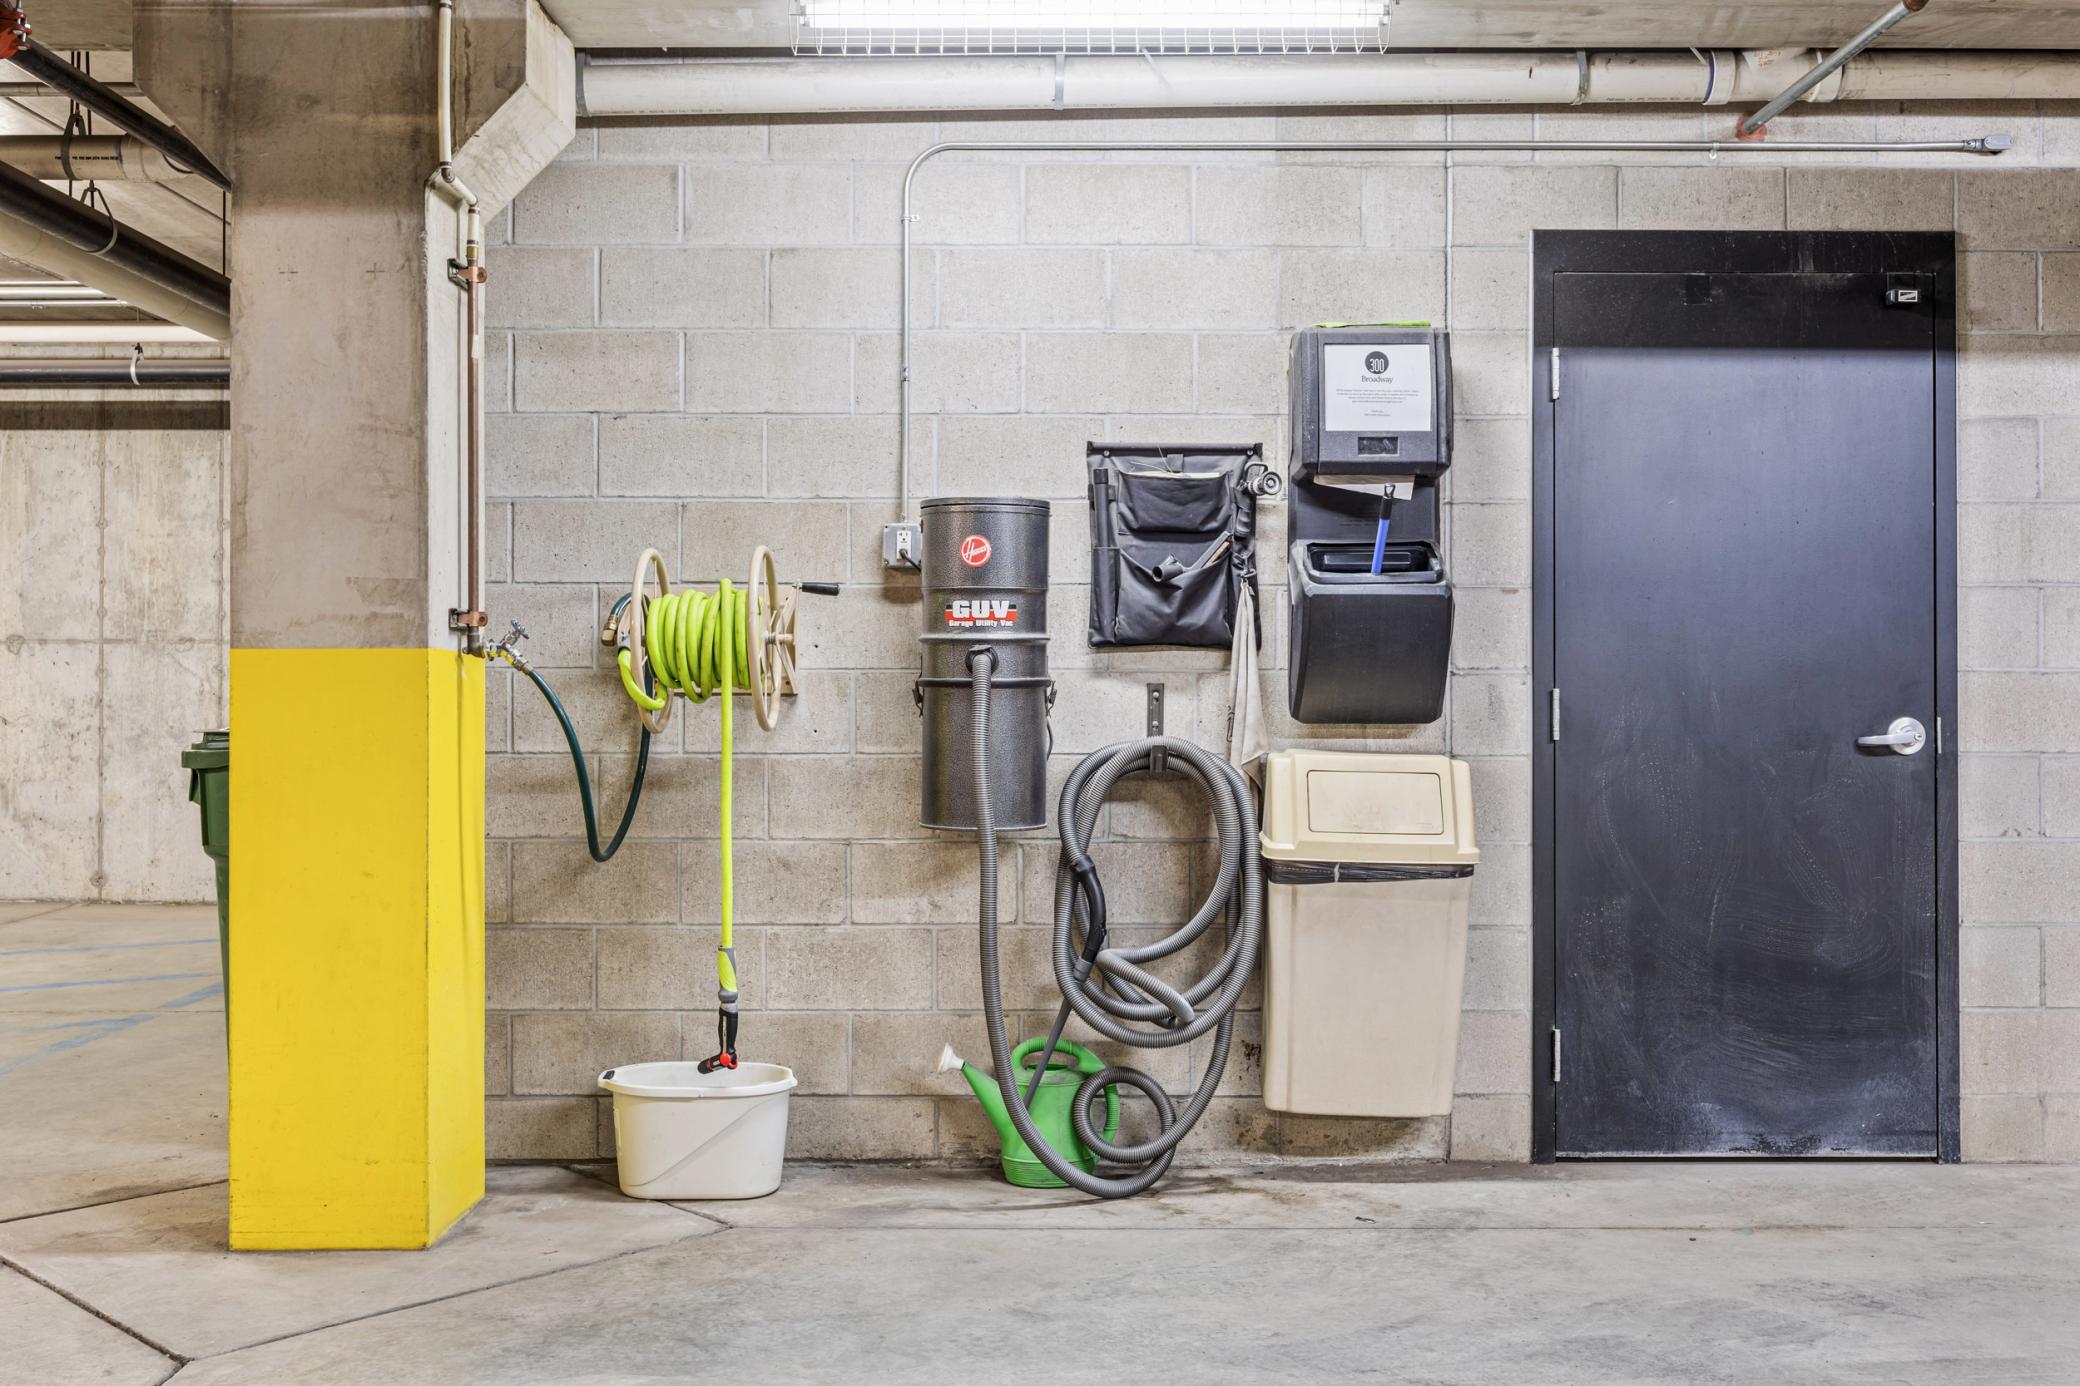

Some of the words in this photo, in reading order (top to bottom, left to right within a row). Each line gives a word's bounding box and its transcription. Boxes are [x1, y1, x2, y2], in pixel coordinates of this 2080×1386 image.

[1369, 358, 1385, 372] 300
[1361, 375, 1393, 384] Broadway
[952, 600, 1010, 618] GUV
